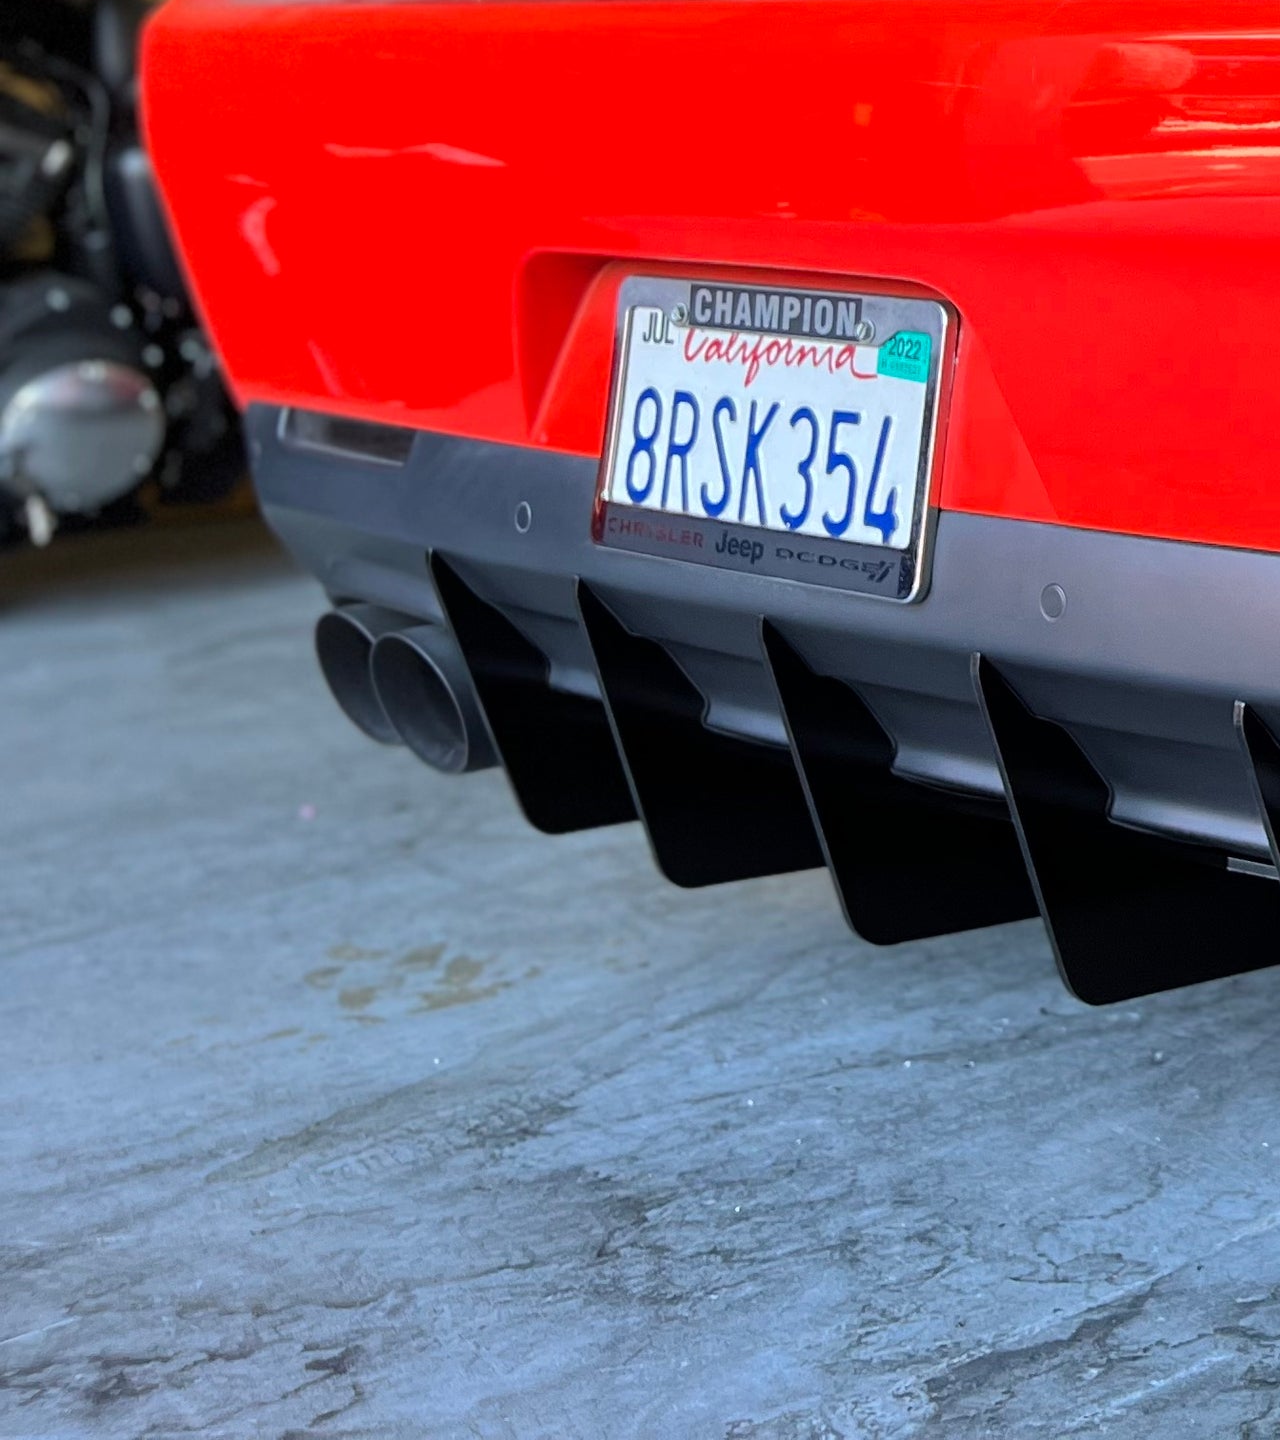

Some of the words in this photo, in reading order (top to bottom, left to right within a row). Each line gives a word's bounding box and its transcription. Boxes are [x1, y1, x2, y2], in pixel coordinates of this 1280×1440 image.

[642, 311, 674, 345] JUL
[694, 287, 858, 338] CHAMPION
[684, 327, 878, 388] California
[888, 337, 922, 361] 2022
[626, 386, 900, 545] 8RSK354
[715, 529, 764, 565] Jeep
